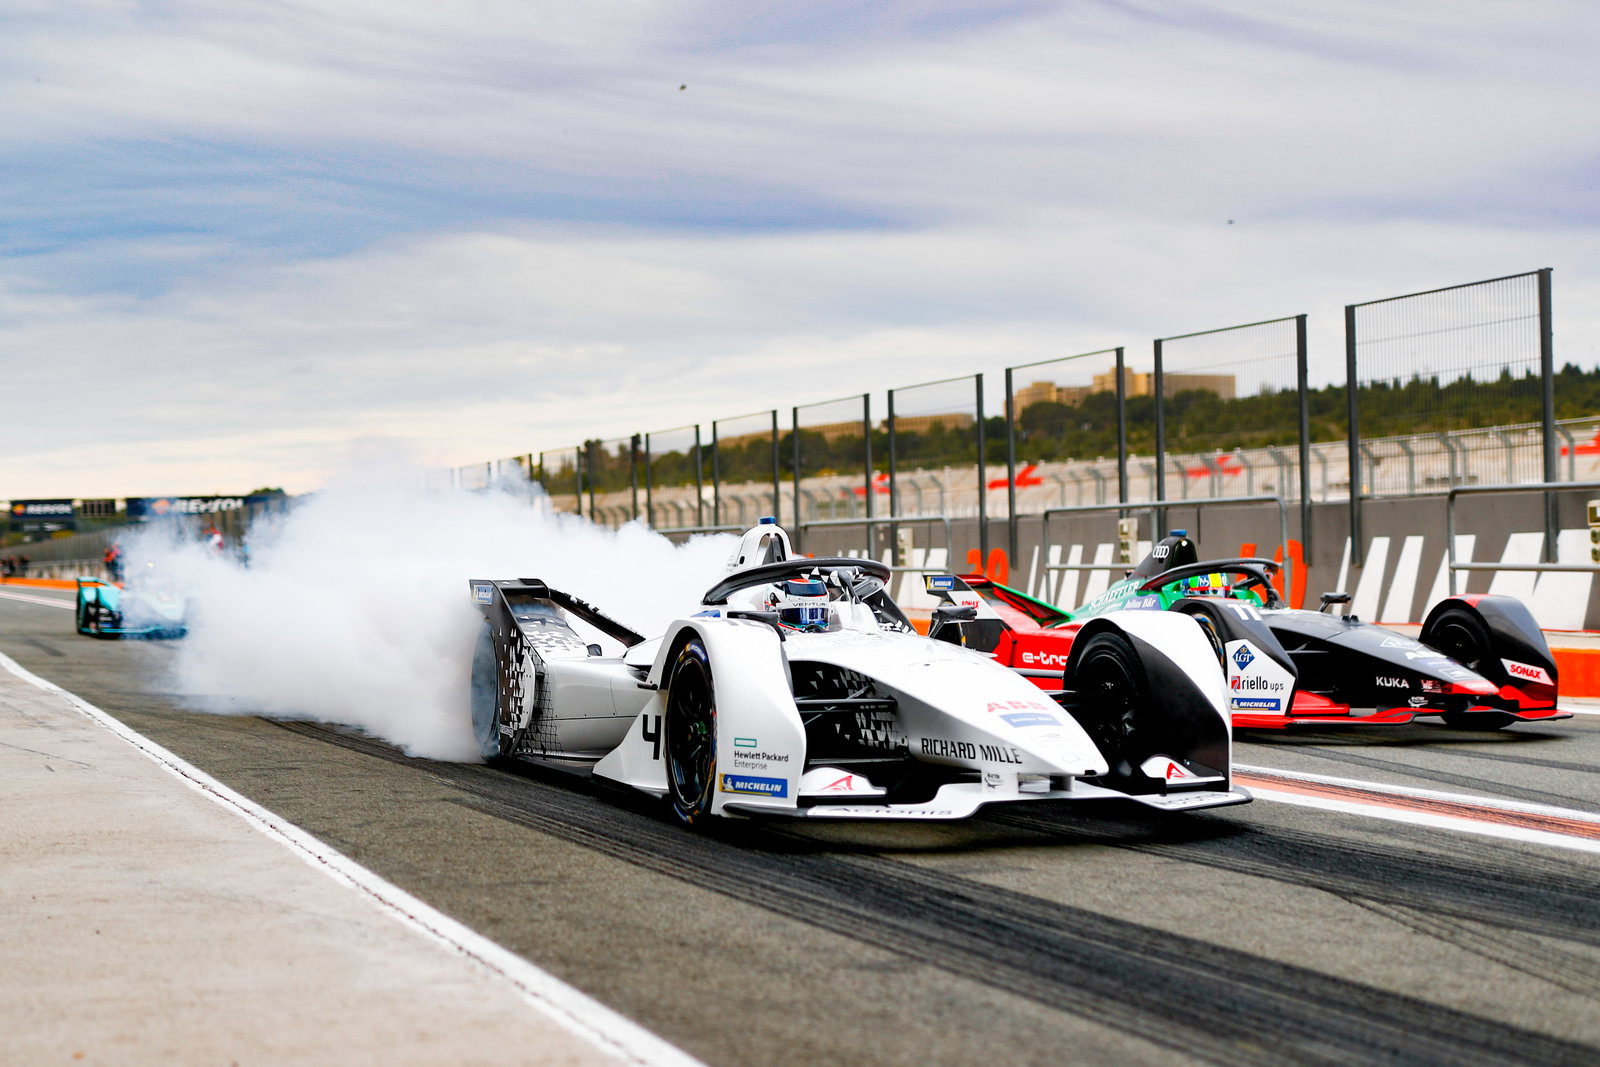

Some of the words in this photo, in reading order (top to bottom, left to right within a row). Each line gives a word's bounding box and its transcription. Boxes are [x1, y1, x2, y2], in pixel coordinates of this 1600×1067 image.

[1088, 580, 1140, 610] SCHAEFFLER
[1124, 599, 1142, 610] Julius
[1226, 603, 1262, 621] 11
[1235, 653, 1252, 663] LGT
[1510, 664, 1541, 679] SONAX
[1242, 675, 1268, 690] riello
[1270, 683, 1284, 693] ups
[1376, 676, 1410, 689] KUKA
[987, 700, 1049, 713] ABB
[642, 713, 661, 760] 4
[734, 750, 761, 760] Hewlett
[762, 752, 789, 762] Packard
[921, 738, 976, 760] RICHARD
[979, 744, 1023, 764] MILLE
[734, 760, 768, 770] Enterprise
[735, 781, 782, 792] MICHELIN
